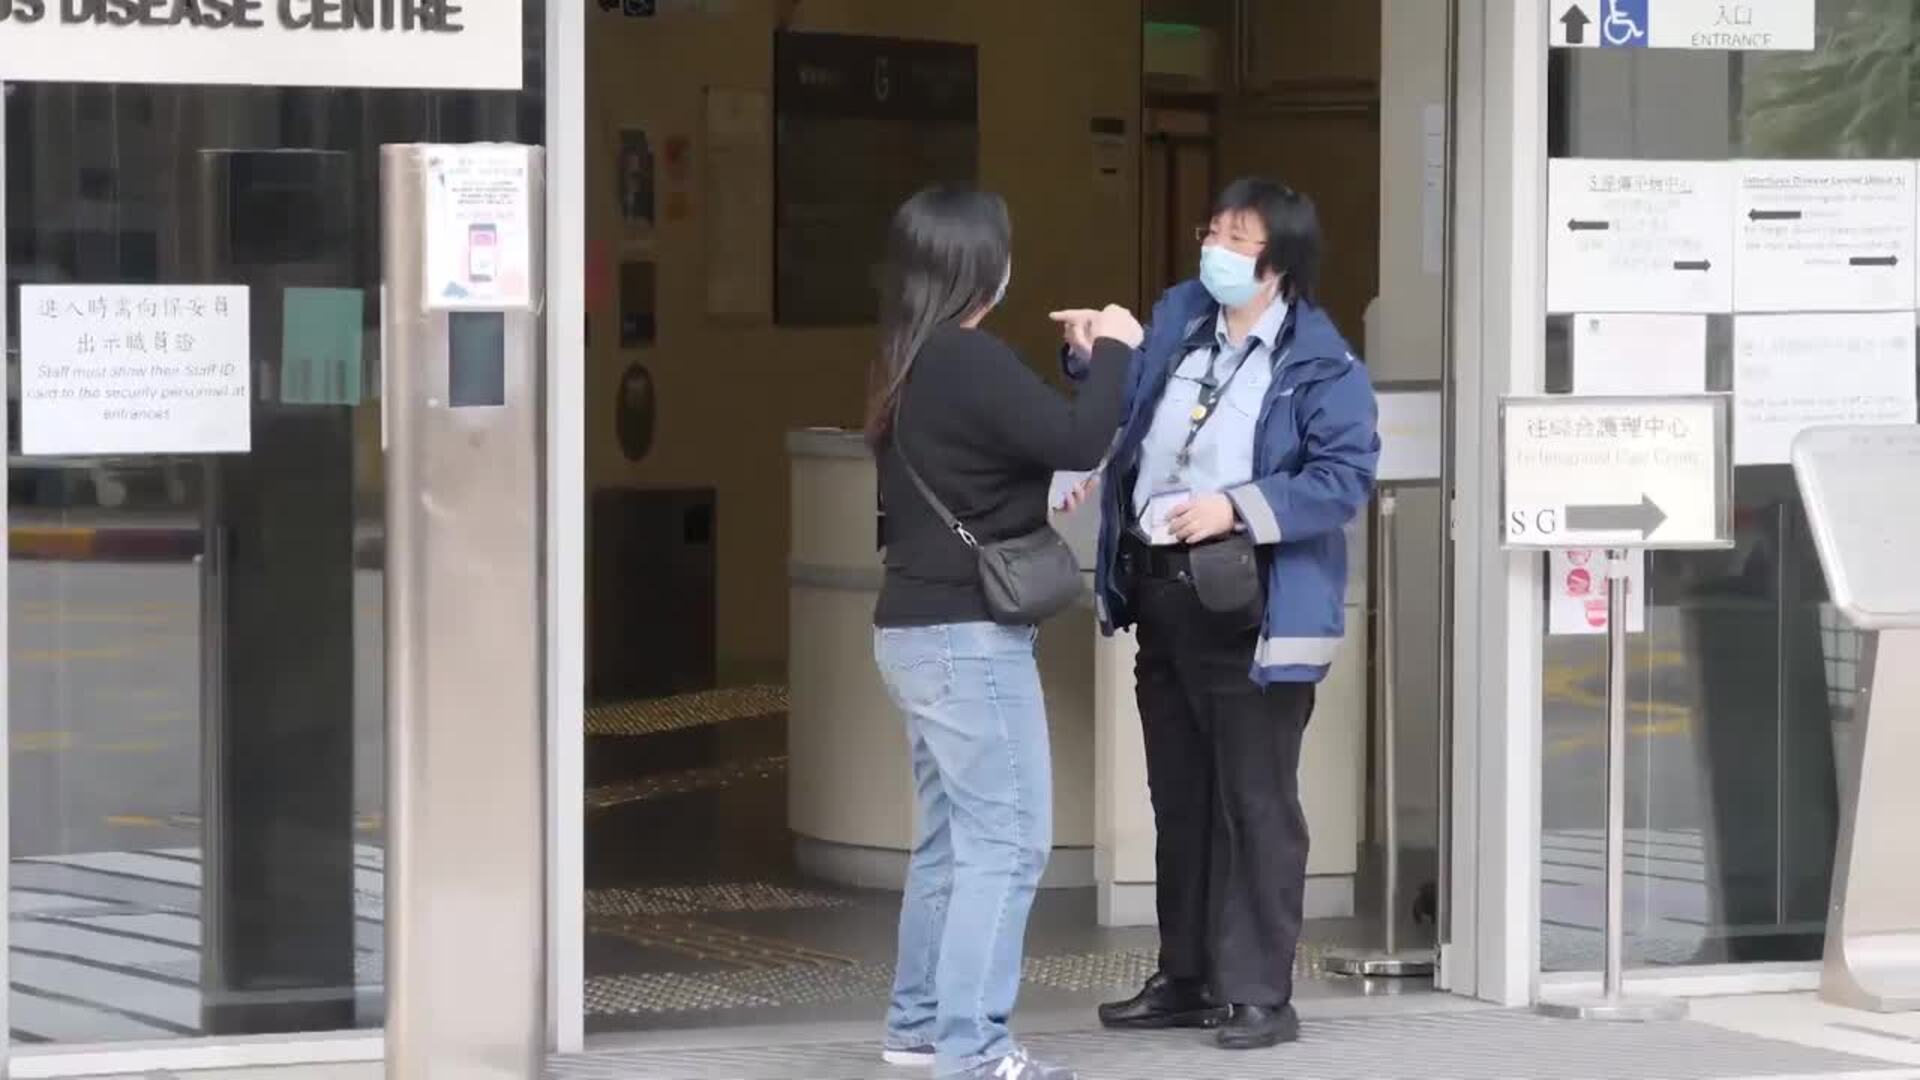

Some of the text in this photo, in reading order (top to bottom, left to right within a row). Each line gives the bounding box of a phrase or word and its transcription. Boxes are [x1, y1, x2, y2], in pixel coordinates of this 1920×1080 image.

[60, 0, 263, 28] DISEASE
[277, 0, 464, 31] CENTRE
[1714, 5, 1752, 25] 入口
[1691, 33, 1773, 47] ENTRANCE
[38, 365, 70, 378] Staff
[104, 386, 157, 401] security
